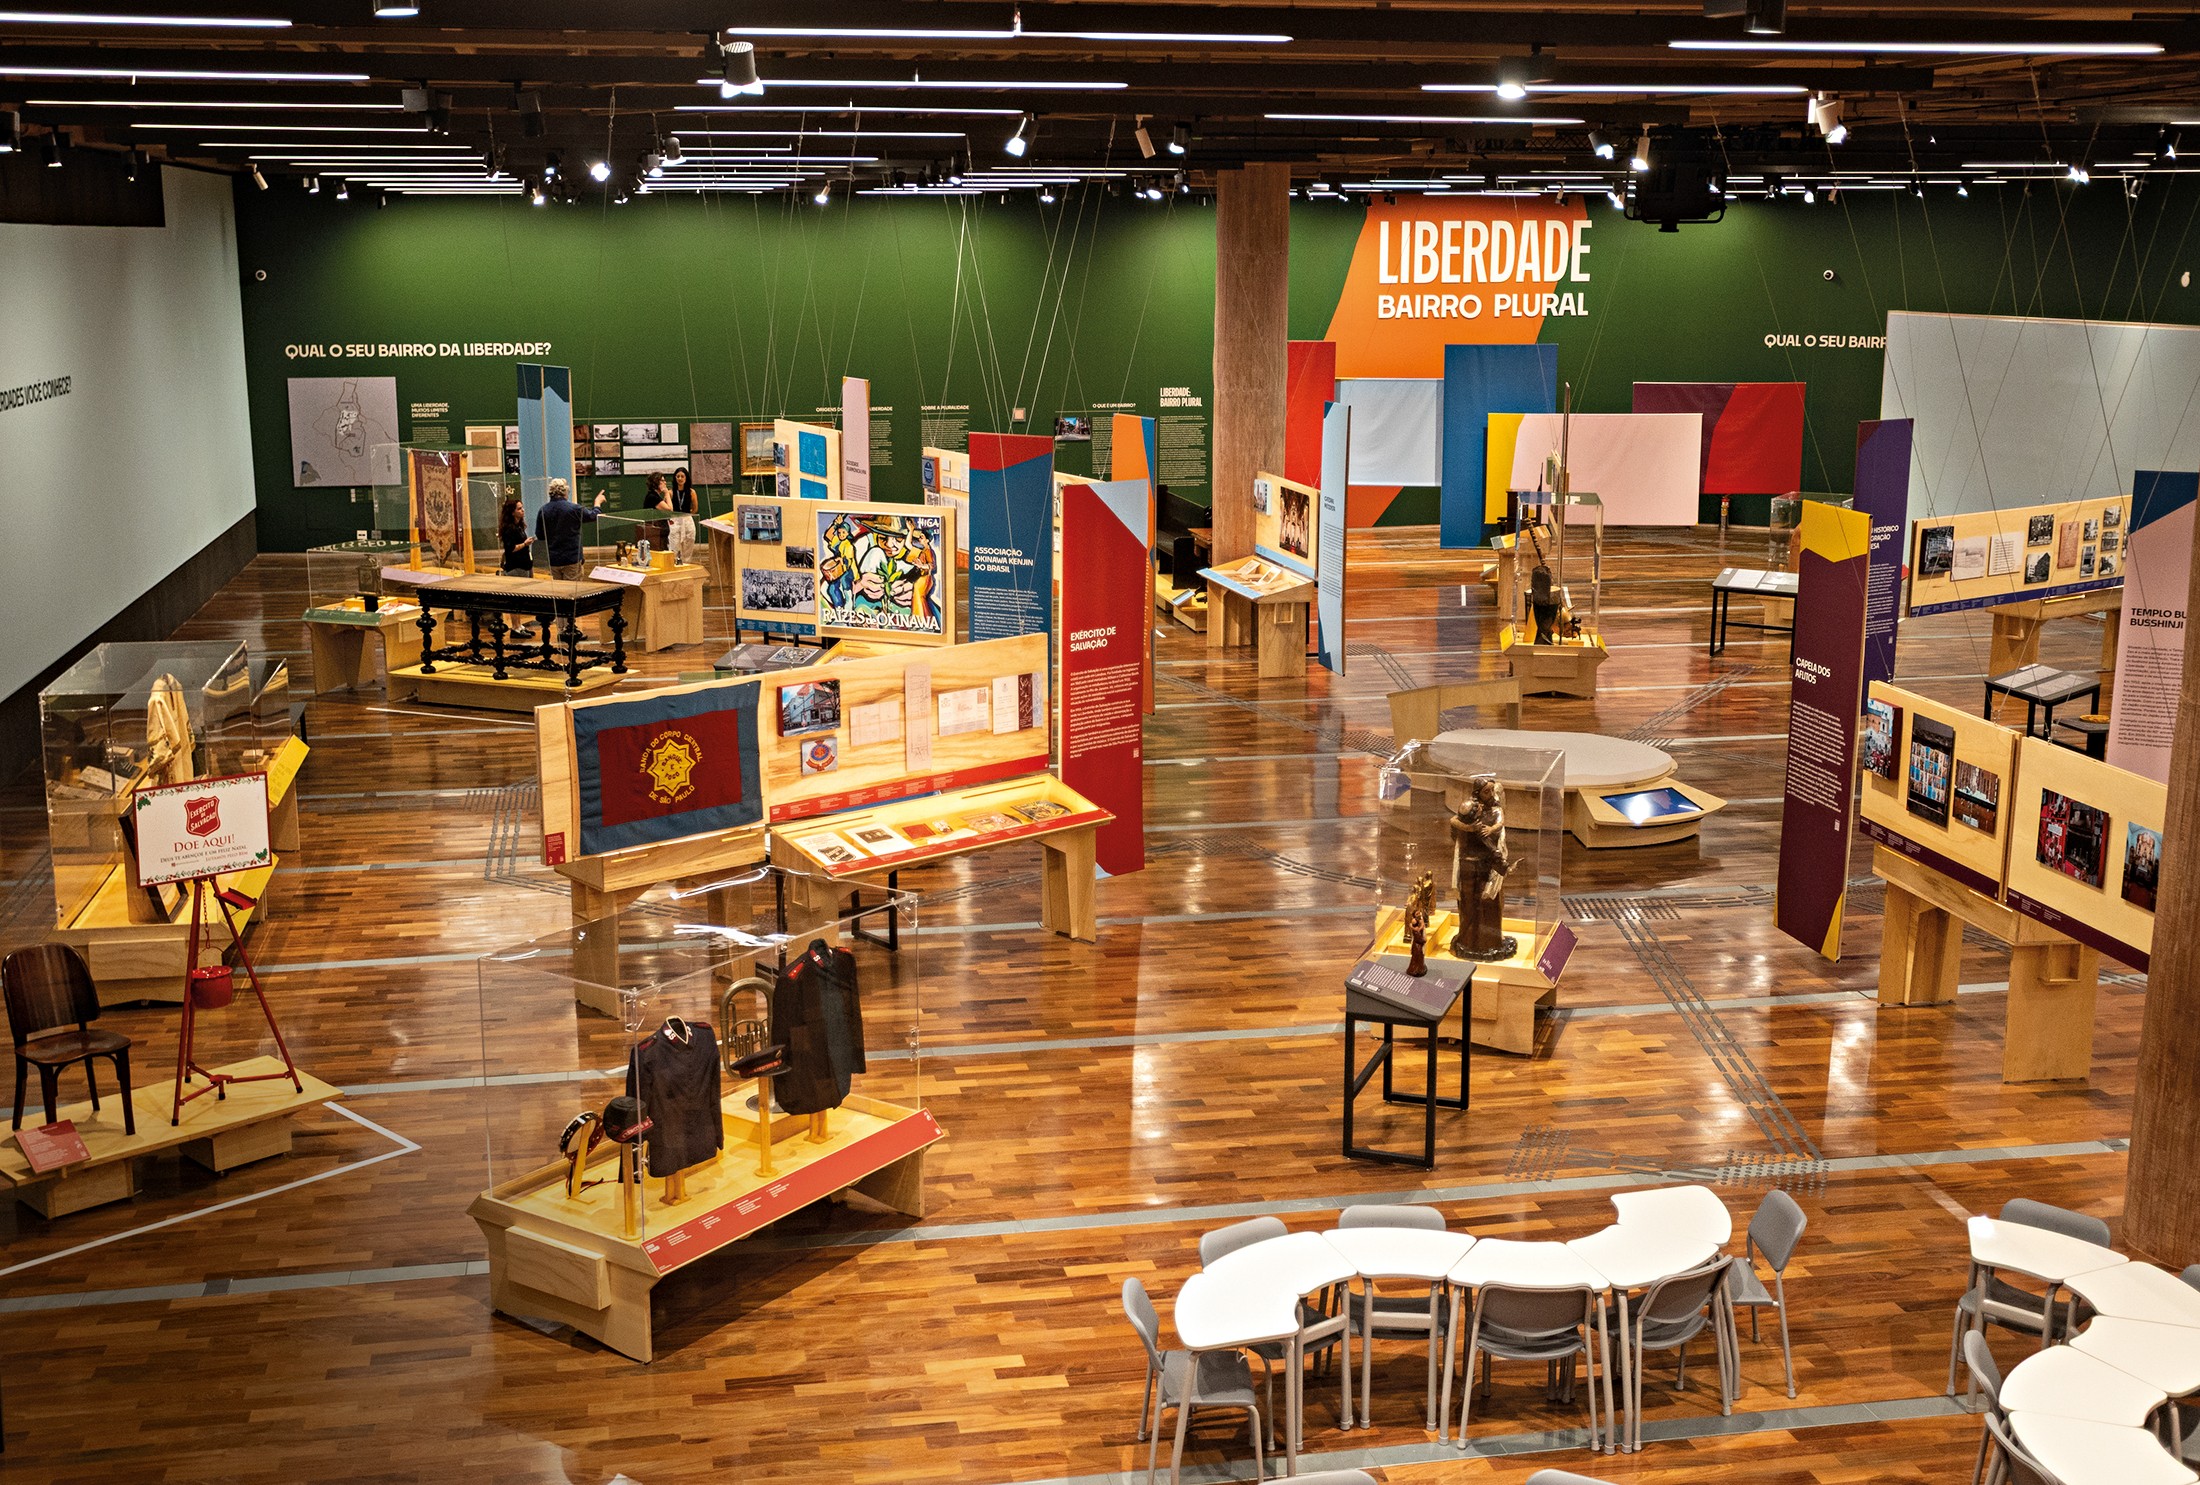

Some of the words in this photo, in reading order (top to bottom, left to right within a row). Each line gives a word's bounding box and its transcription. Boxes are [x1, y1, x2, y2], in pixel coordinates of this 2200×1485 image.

[1379, 220, 1592, 284] LIBERDADE
[1378, 294, 1482, 319] BAIRRO
[1494, 292, 1588, 317] PLURAL
[1764, 334, 1801, 348] QUAL
[1804, 335, 1817, 347] O
[1819, 335, 1846, 347] SEU
[285, 344, 326, 360] QUAL
[329, 344, 343, 358] O
[345, 344, 375, 358] SEU
[378, 343, 437, 358] BAIRRO
[439, 343, 461, 357] DA
[463, 342, 552, 356] LIBERDADE?
[1160, 387, 1191, 397] LIBERDADE:
[1160, 397, 1180, 407] BAIRRO
[1182, 397, 1202, 407] PLURAL
[917, 517, 940, 529] HIGA
[974, 546, 1023, 557] ASSOCIAÇÃO
[974, 555, 1008, 565] OKINAWA
[1008, 557, 1034, 566] KENJIN
[974, 563, 986, 571] DO
[986, 564, 1010, 573] BRASIL
[2131, 608, 2173, 618] TEMPLO
[2130, 618, 2184, 629] BUSSHINJI
[1070, 627, 1106, 641] EXÉRCITO
[1106, 626, 1117, 636] DE
[1070, 638, 1108, 652] SALVAÇÃO
[1795, 656, 1818, 673] CAPELA
[1817, 664, 1831, 678] DOS
[1794, 668, 1817, 685] AFLITOS
[639, 747, 652, 773] BANDA
[650, 738, 660, 748] DO
[659, 730, 681, 740] CORPO
[683, 733, 703, 763] CENTRAL
[648, 791, 659, 801] DE
[674, 784, 696, 803] PAULO
[174, 840, 200, 853] DOE
[202, 833, 236, 849] AQUI!
